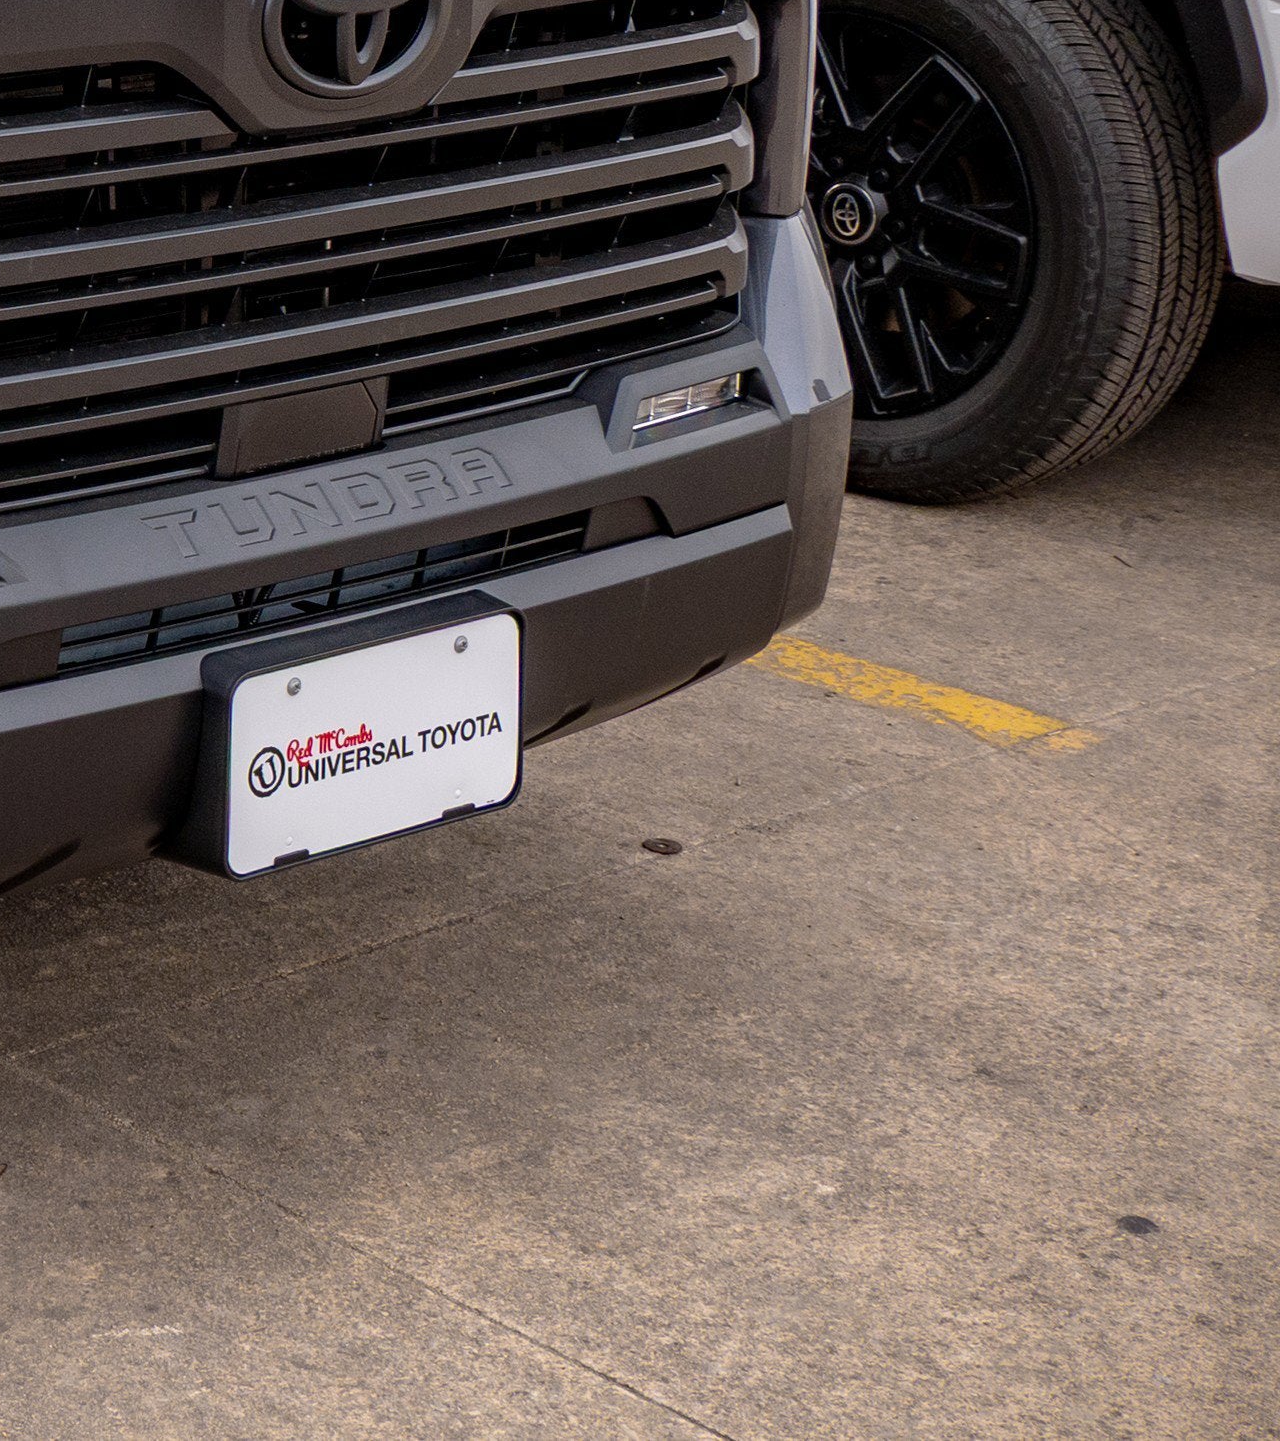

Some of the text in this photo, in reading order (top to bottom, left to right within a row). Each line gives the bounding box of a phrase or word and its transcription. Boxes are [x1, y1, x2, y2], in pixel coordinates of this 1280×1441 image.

[139, 446, 514, 560] TUNDRA
[286, 722, 373, 768] Red McCombs
[287, 711, 503, 789] UNIVERSAL TOYOTA
